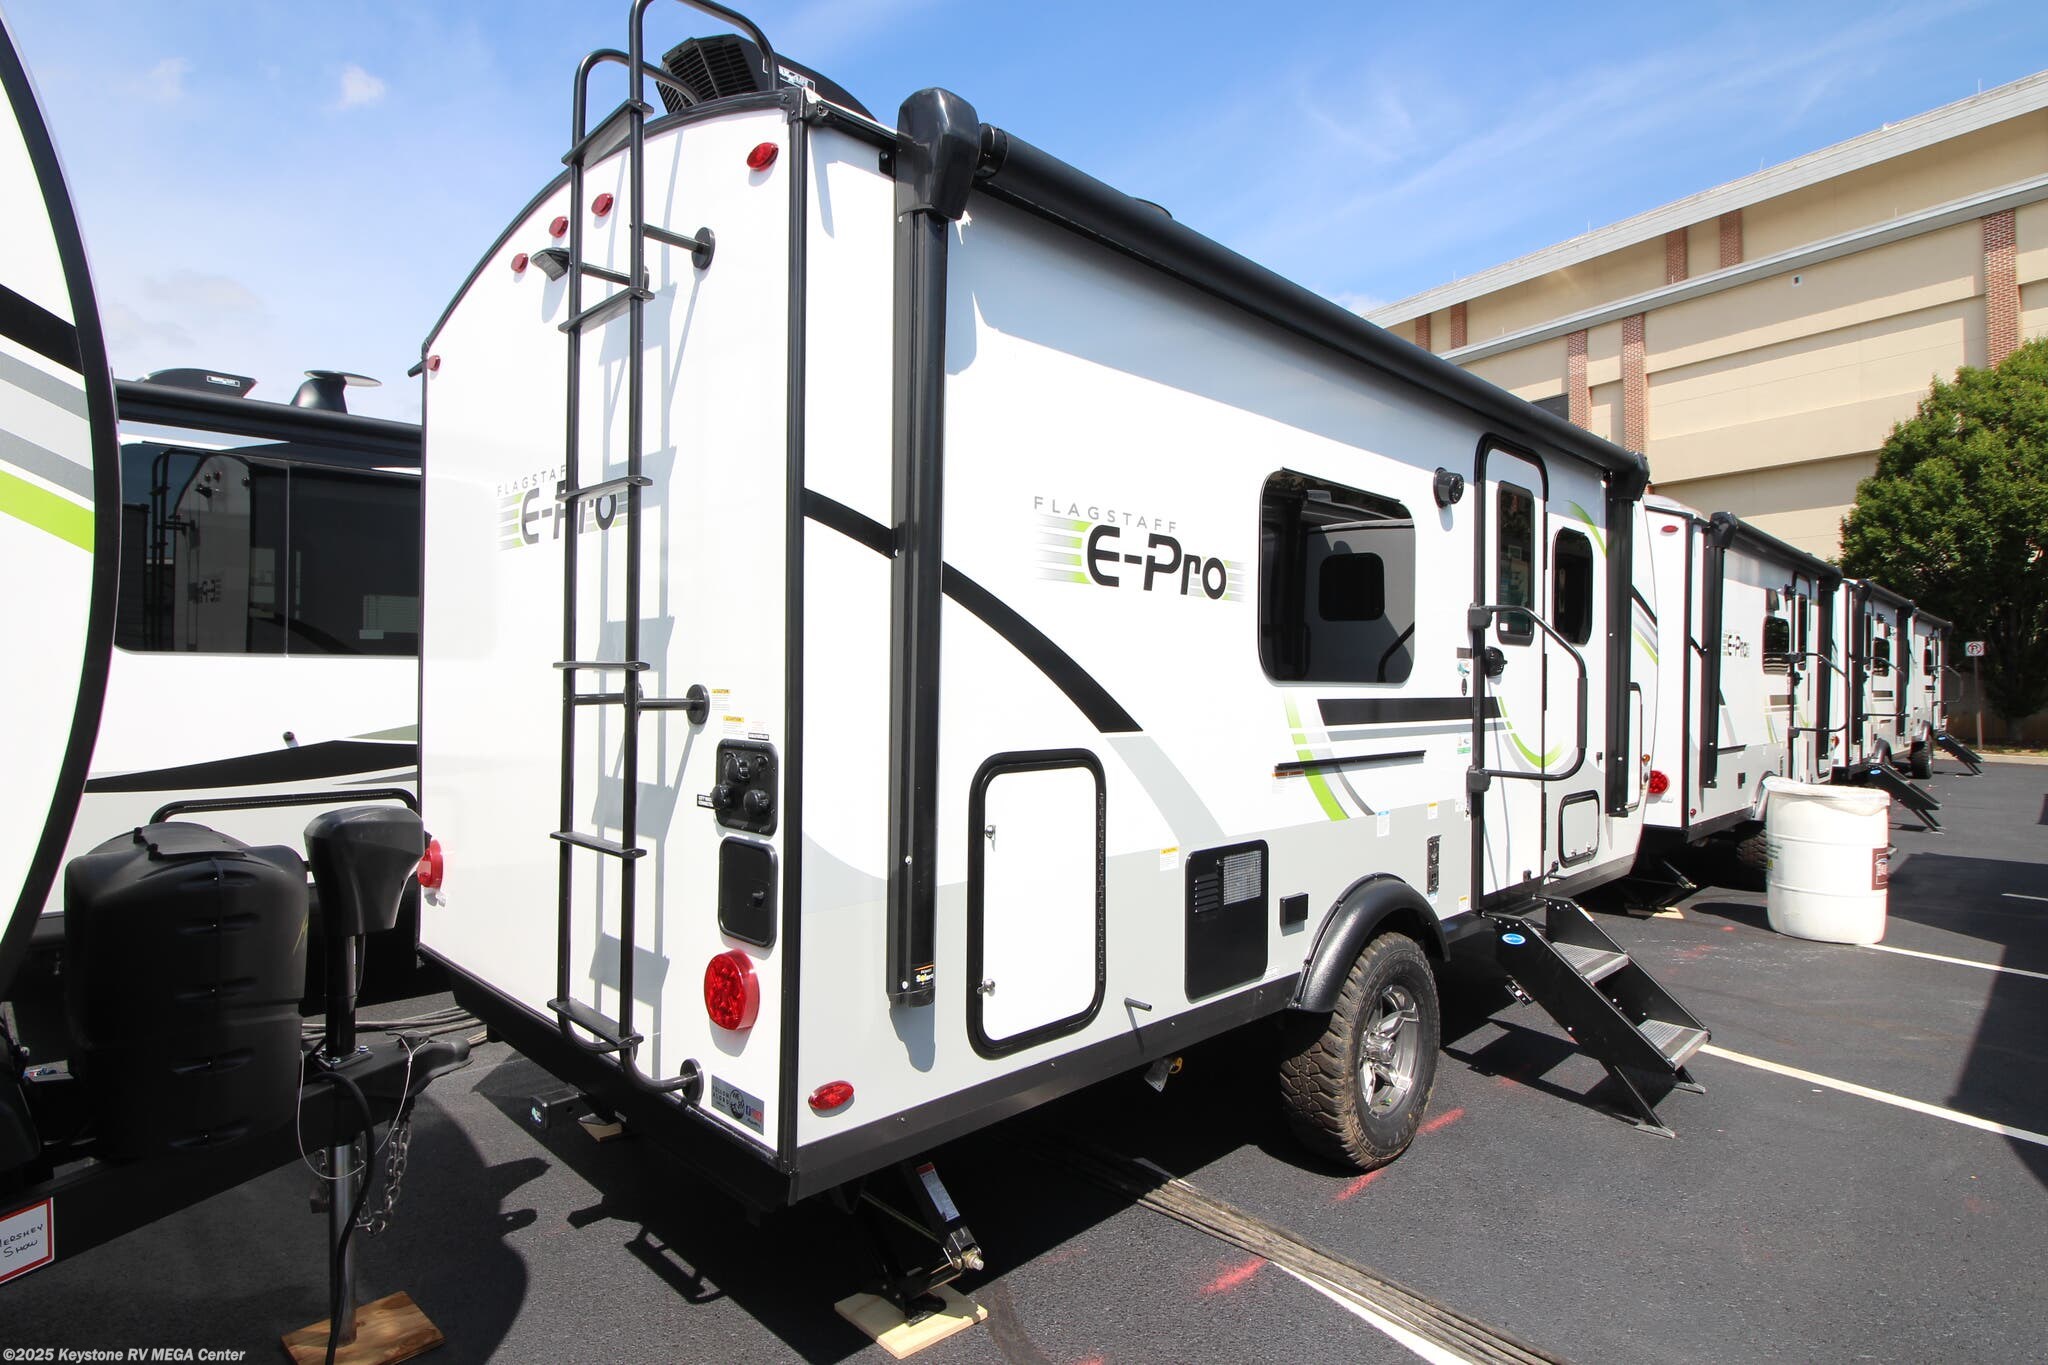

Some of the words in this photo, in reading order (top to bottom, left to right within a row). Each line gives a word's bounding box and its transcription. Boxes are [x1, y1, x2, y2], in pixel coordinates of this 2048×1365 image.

[496, 464, 567, 496] FLAGSTAF
[1033, 495, 1178, 533] FLAGSTAFF
[1087, 524, 1228, 600] E-Pro
